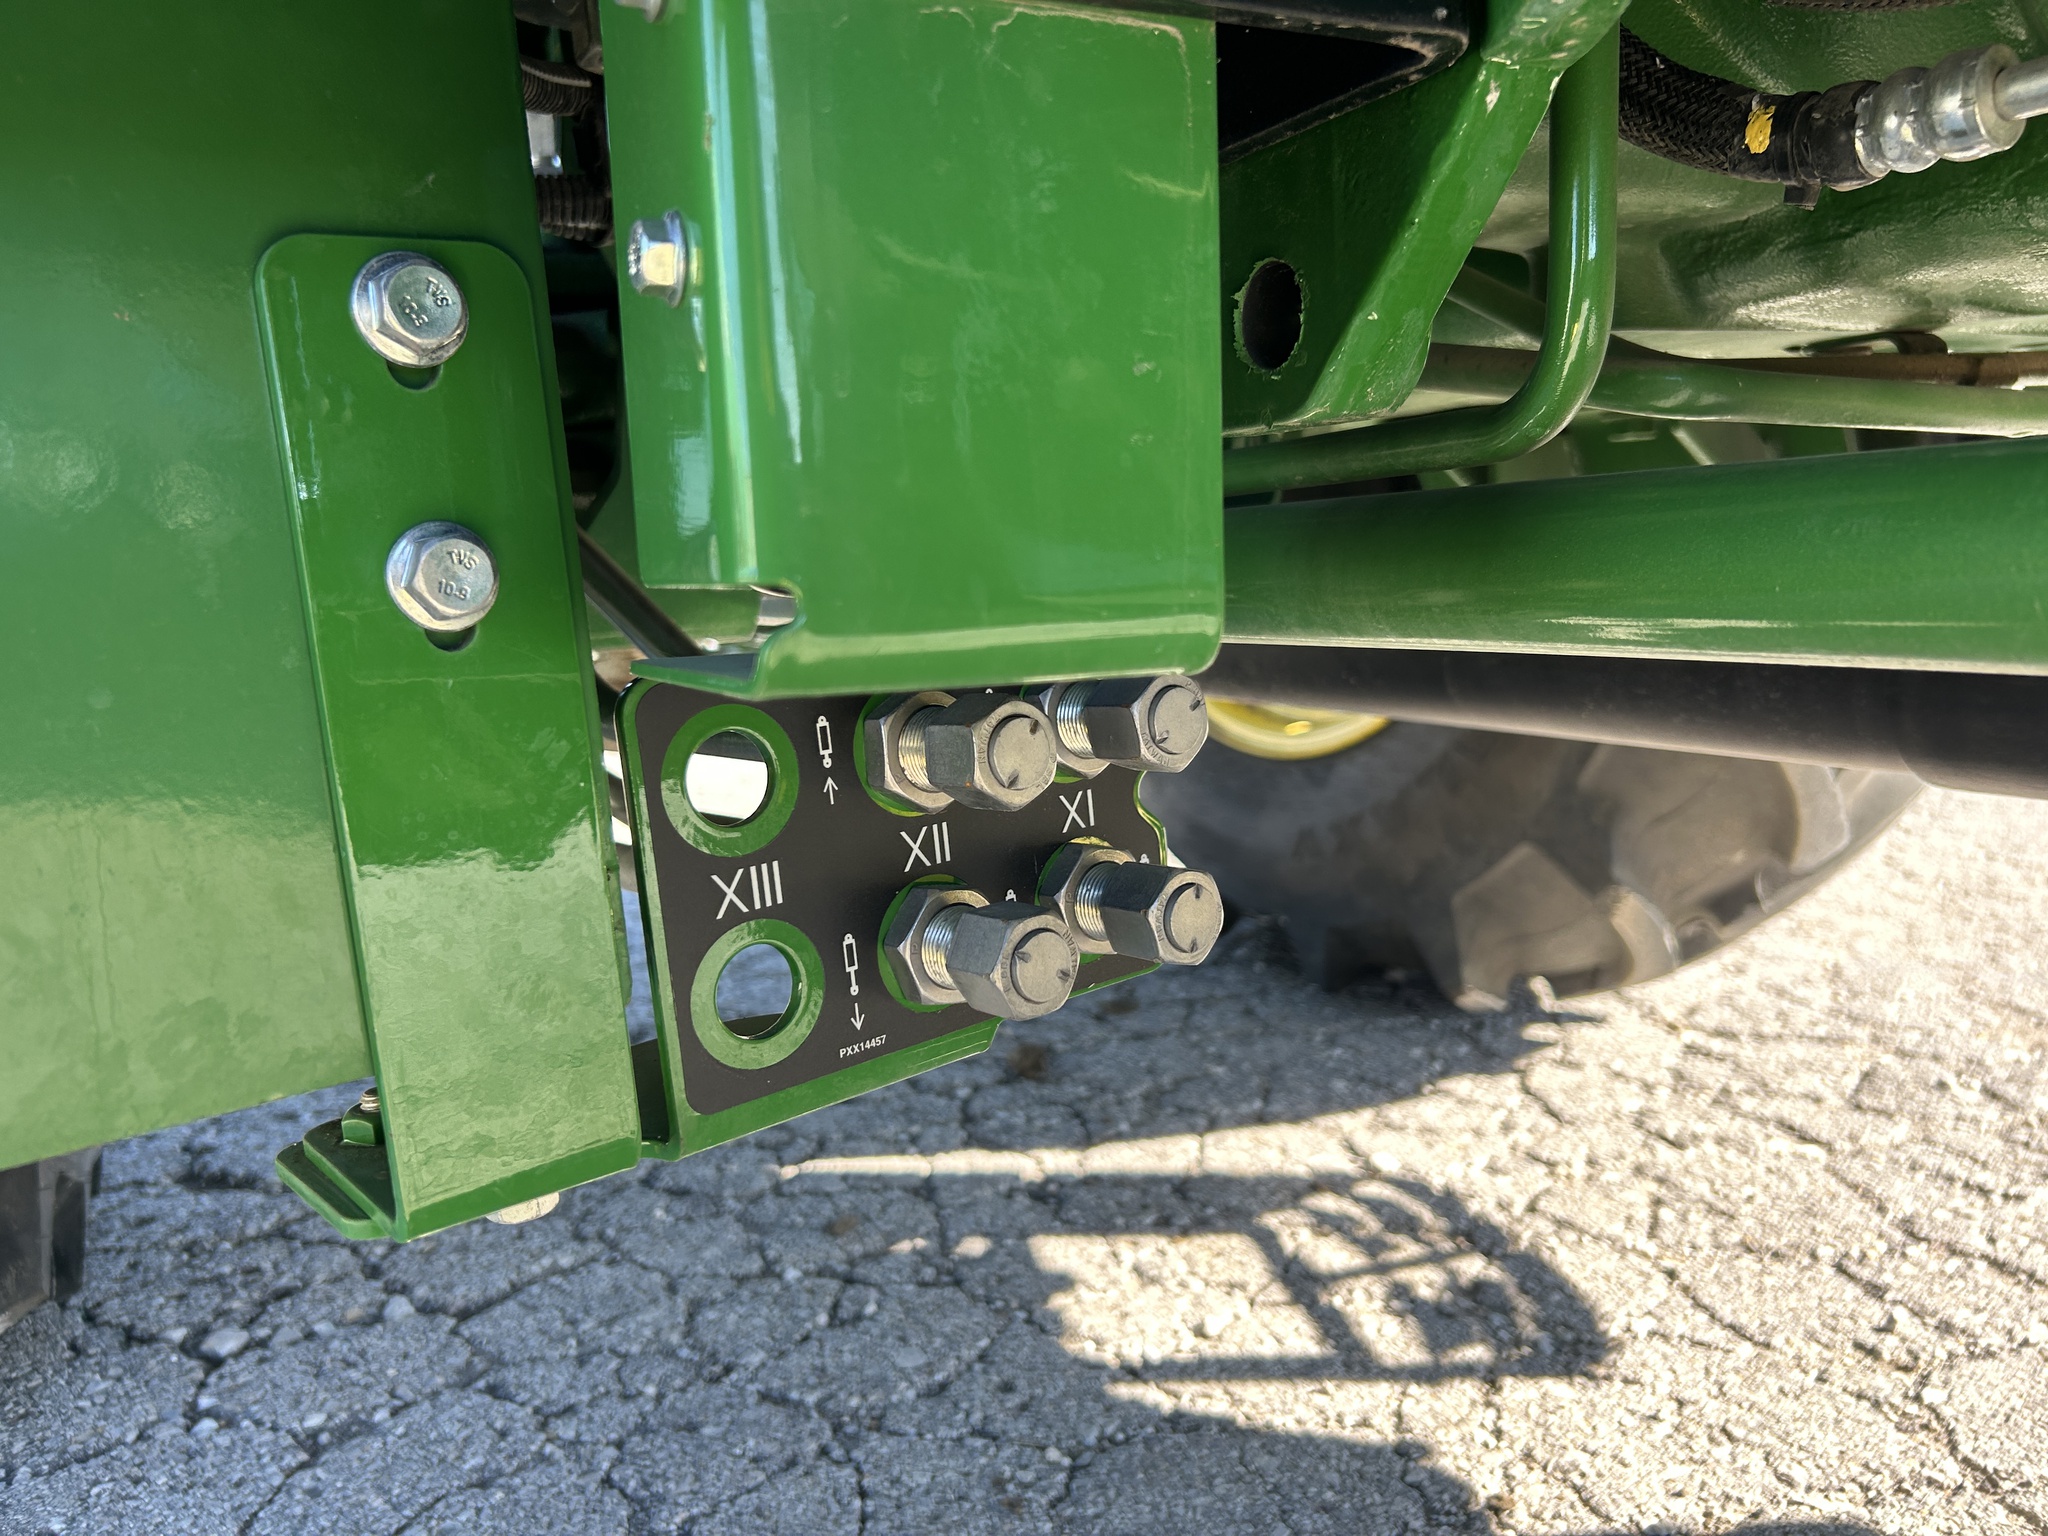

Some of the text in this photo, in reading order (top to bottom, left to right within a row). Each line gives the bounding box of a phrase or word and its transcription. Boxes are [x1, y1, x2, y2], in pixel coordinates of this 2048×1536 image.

[1058, 788, 1096, 834] XI
[900, 821, 952, 873] XII
[710, 860, 784, 920] XIII
[839, 1034, 887, 1059] PXX14457
